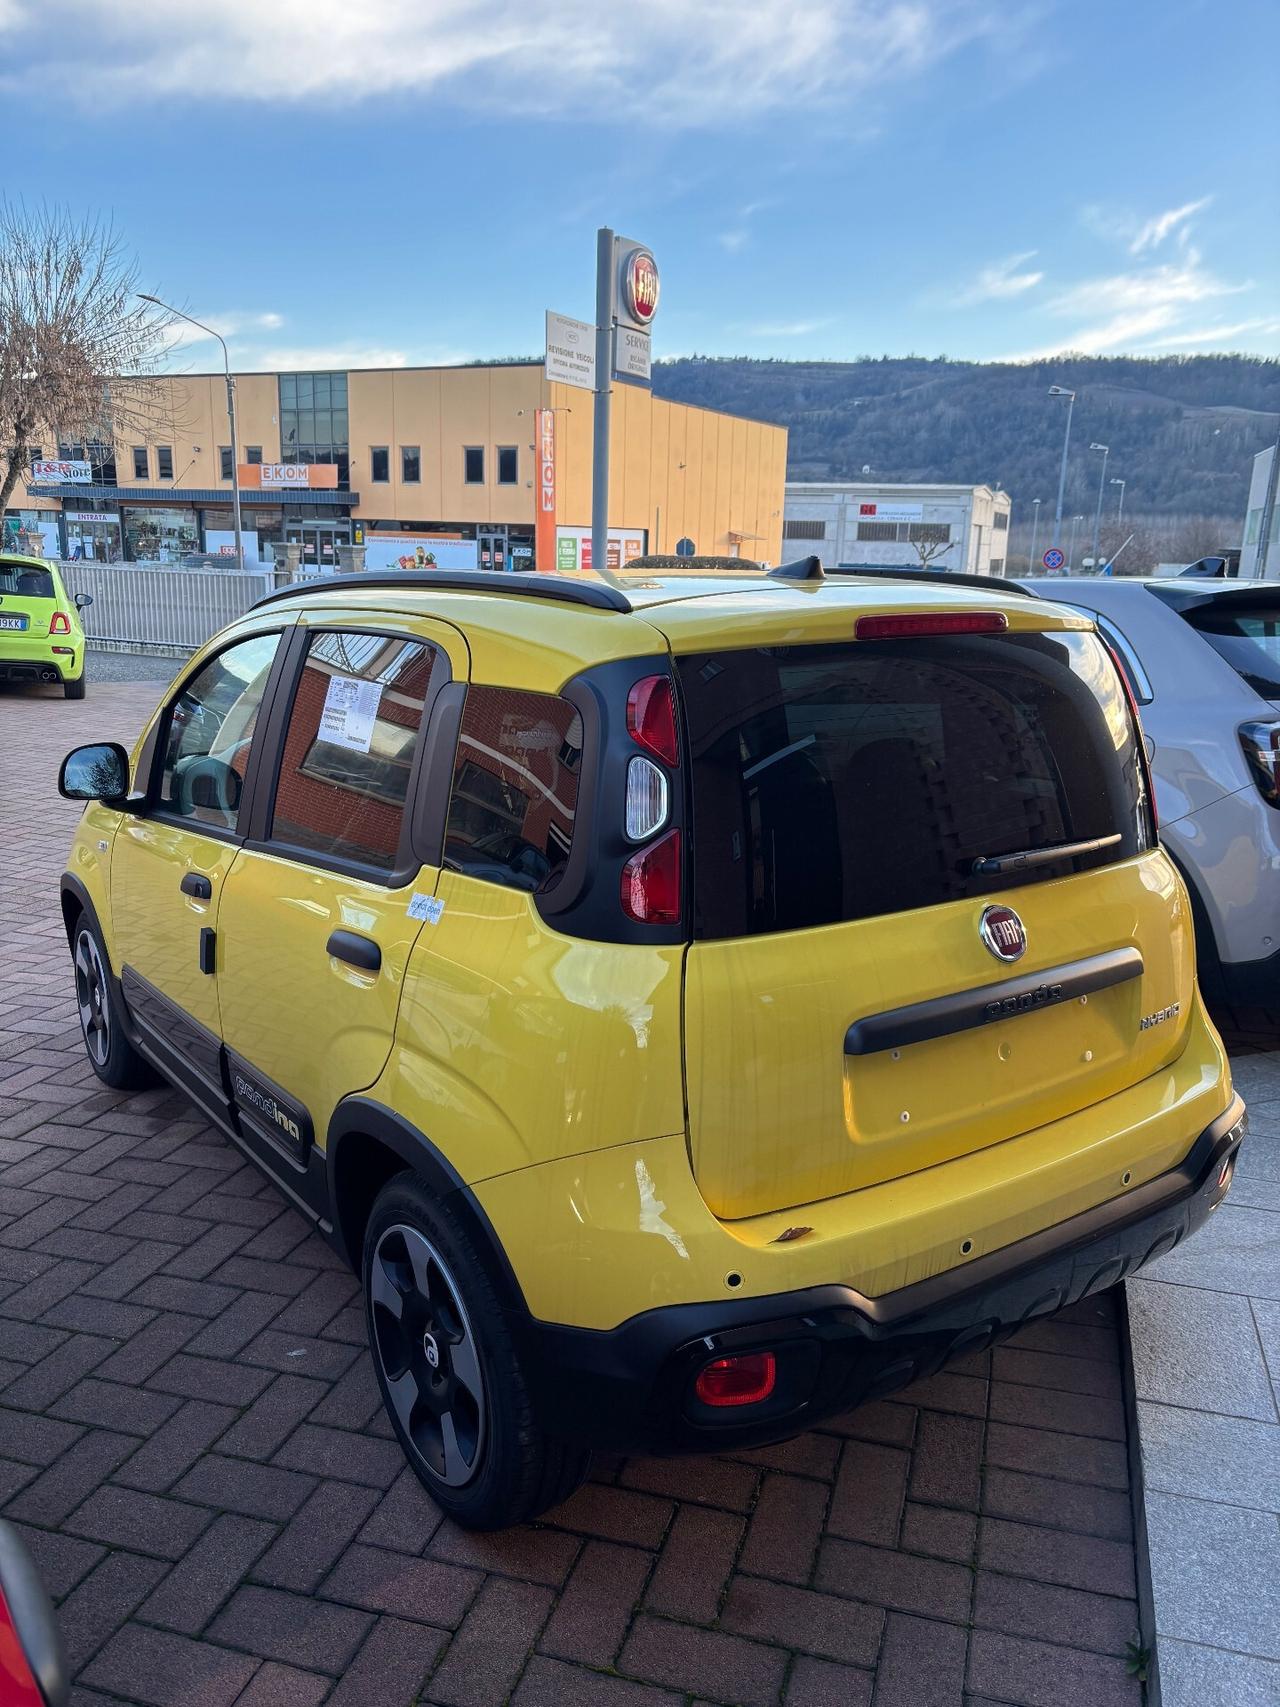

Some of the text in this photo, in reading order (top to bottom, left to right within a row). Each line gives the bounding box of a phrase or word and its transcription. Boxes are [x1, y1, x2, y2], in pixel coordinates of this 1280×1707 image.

[263, 467, 307, 479] EKOM
[77, 513, 108, 521] ENTRATA
[0, 619, 20, 628] 9KK
[991, 918, 1020, 948] FIAT
